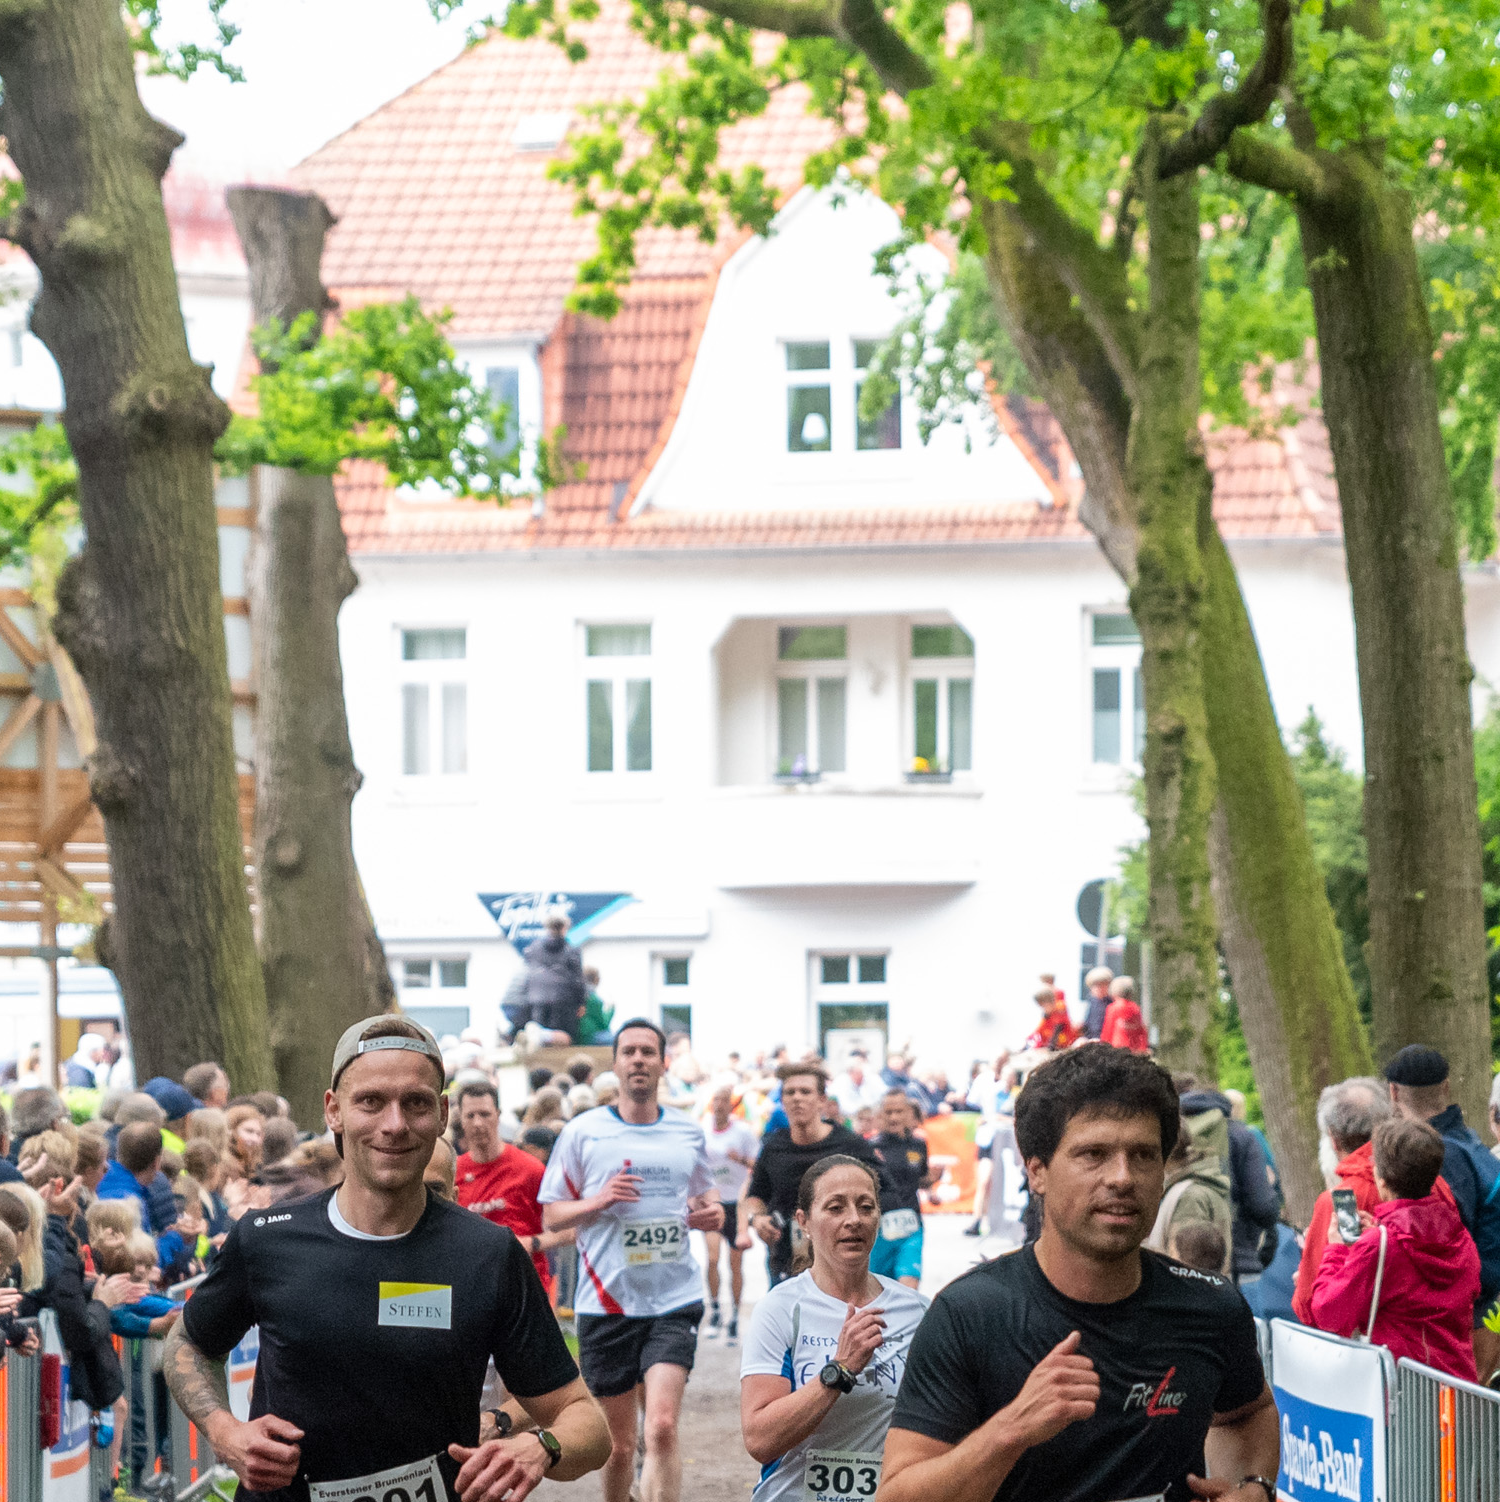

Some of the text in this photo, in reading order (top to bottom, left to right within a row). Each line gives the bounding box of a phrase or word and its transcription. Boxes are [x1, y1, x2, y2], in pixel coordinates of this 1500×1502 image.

[267, 1213, 292, 1225] JAKO
[623, 1226, 680, 1248] 2492
[389, 1303, 442, 1318] STEFEN
[855, 1457, 883, 1466] Brunne
[318, 1465, 433, 1499] Everstener Brunnenlauf
[807, 1464, 878, 1496] 303
